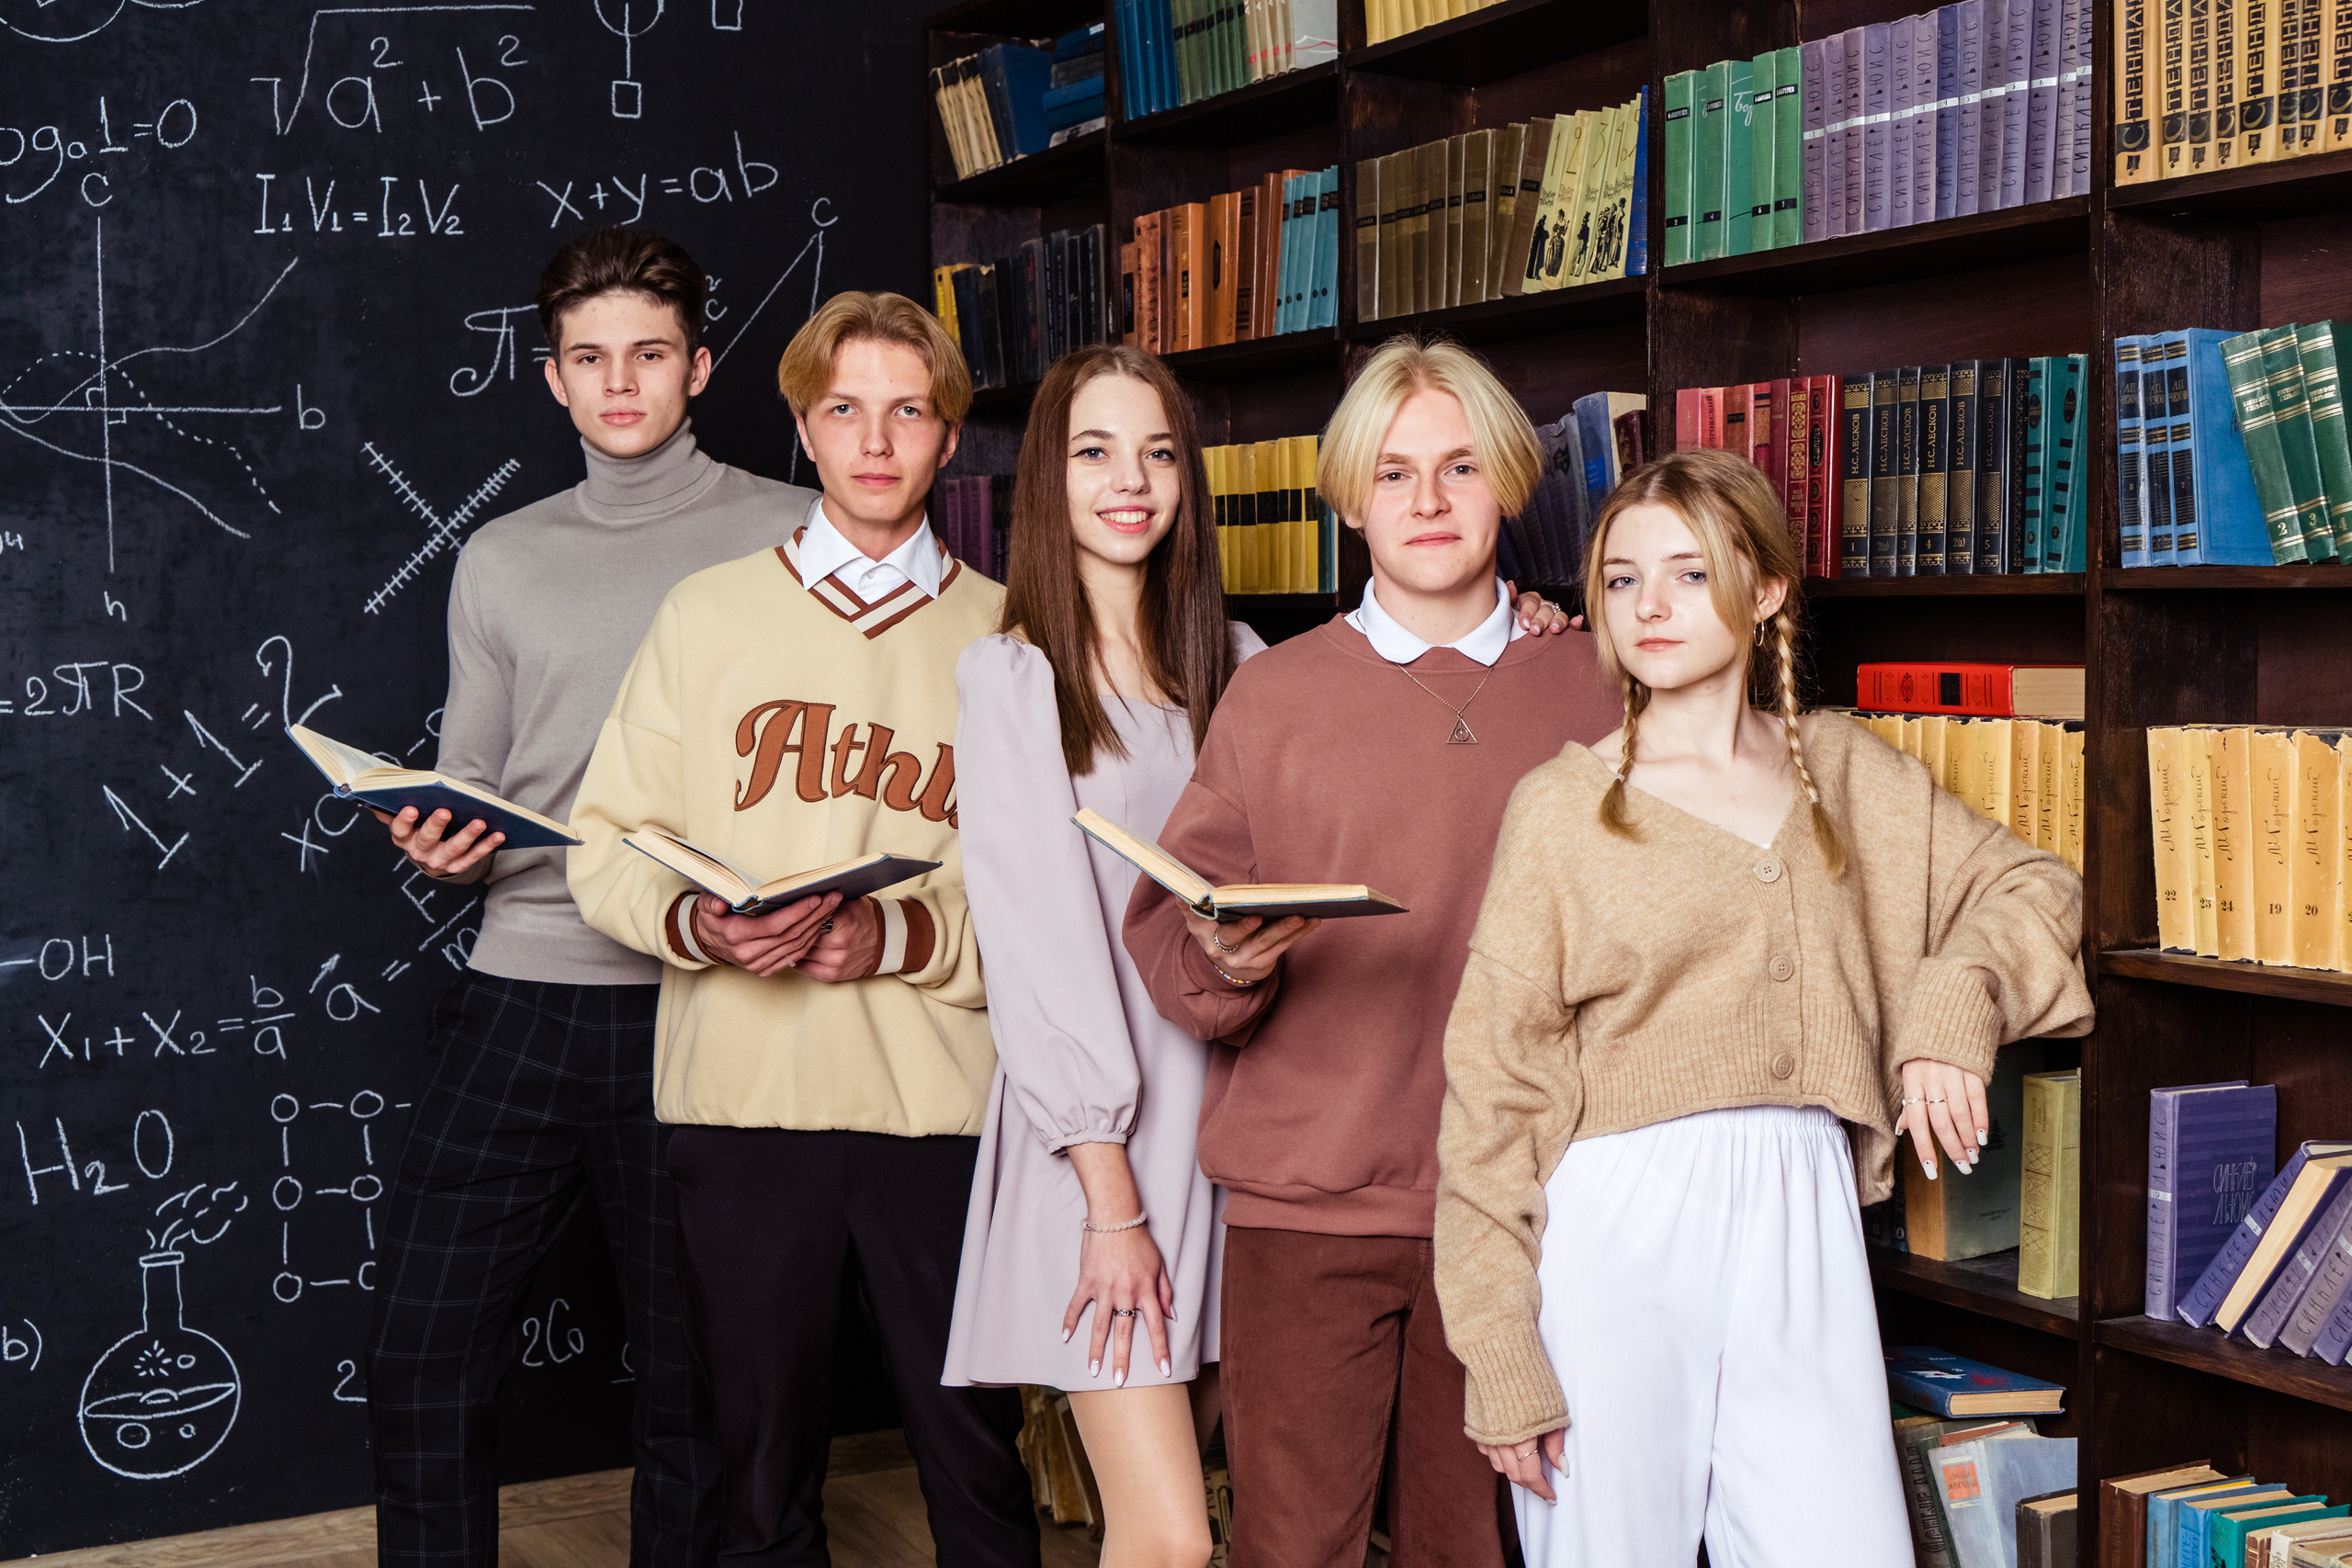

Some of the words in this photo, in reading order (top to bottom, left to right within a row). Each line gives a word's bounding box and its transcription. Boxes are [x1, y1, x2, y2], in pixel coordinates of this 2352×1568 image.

[2309, 513, 2317, 526] 3
[2339, 517, 2347, 531] 4
[2278, 522, 2288, 536] 2
[1901, 540, 1907, 550] 3
[1926, 539, 1932, 550] 4
[1984, 540, 1990, 550] 5
[2165, 889, 2177, 902] 22
[2221, 900, 2234, 912] 24
[2268, 903, 2282, 915] 19
[2305, 904, 2319, 917] 20
[2148, 1202, 2166, 1297] СИНКЛЕР
